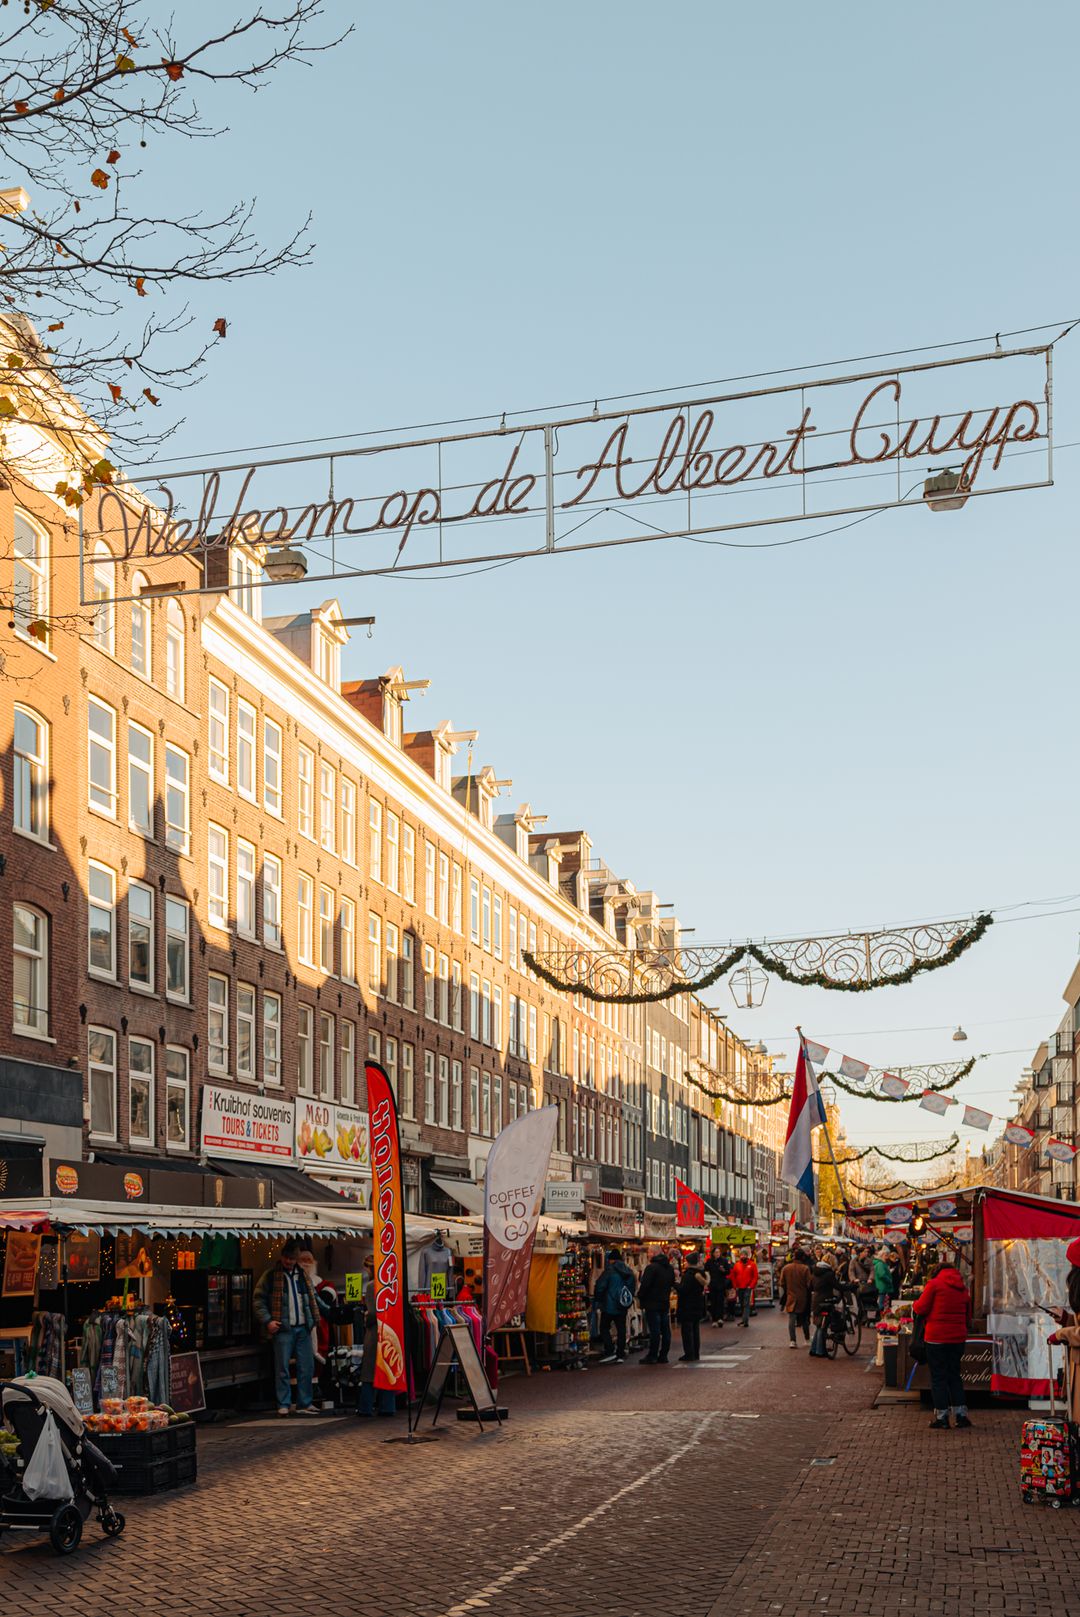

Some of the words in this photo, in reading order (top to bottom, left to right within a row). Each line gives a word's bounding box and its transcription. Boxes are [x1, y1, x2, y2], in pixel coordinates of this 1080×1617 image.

[98, 466, 354, 560] Welkom
[379, 487, 440, 551] op
[466, 444, 537, 515] de
[561, 406, 817, 508] Albert
[839, 379, 1041, 491] Cuyp
[213, 1091, 251, 1115] Kruithof
[252, 1103, 291, 1124] souvenirs
[305, 1104, 330, 1127] M&D
[222, 1116, 245, 1137] TOURS
[245, 1122, 251, 1138] &
[252, 1121, 280, 1142] TICKETS
[489, 1184, 536, 1205] COFFEE
[499, 1202, 527, 1222] TO
[504, 1221, 529, 1242] GO
